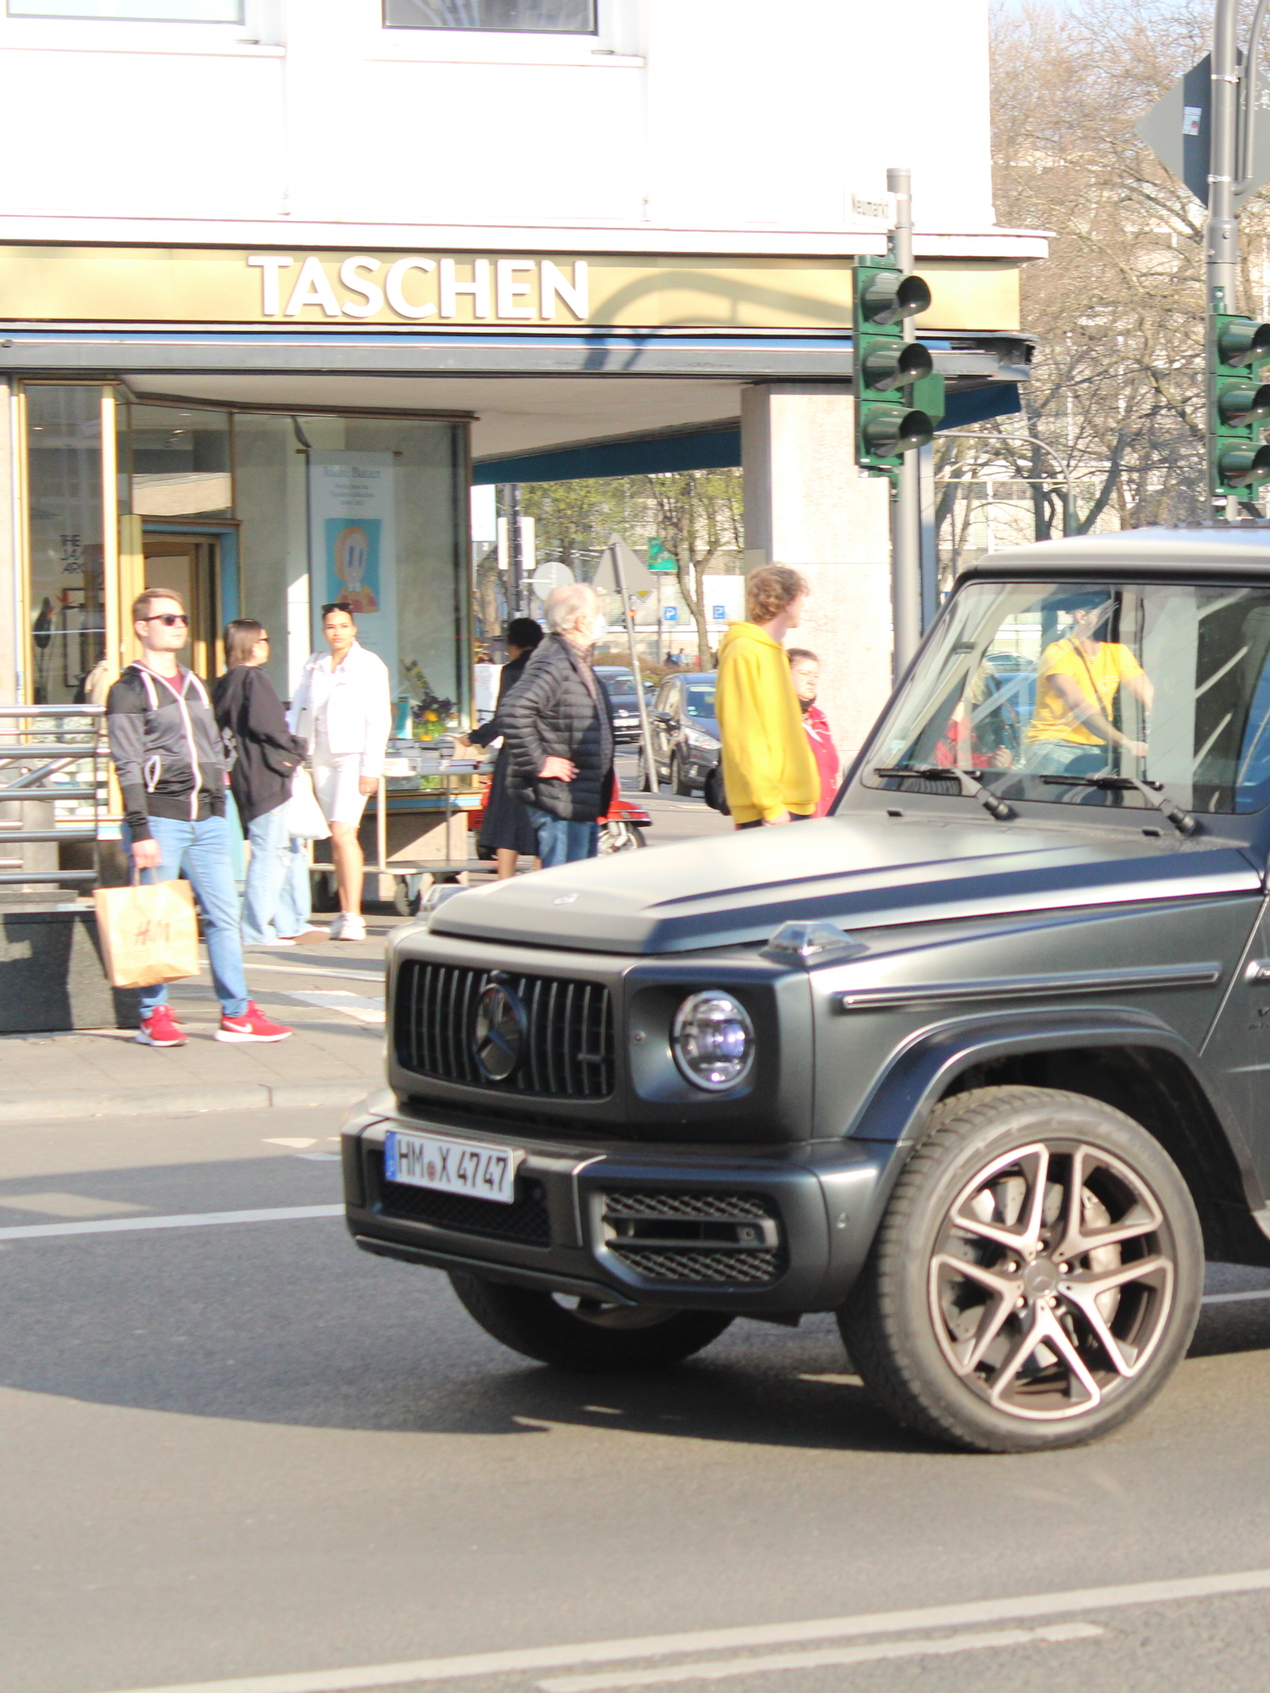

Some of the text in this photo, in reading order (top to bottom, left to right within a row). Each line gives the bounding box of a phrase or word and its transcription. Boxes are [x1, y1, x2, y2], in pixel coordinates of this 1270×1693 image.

[851, 193, 889, 219] Neumarkt
[248, 255, 588, 319] TASCHEN
[398, 1139, 509, 1193] HM X 4747
